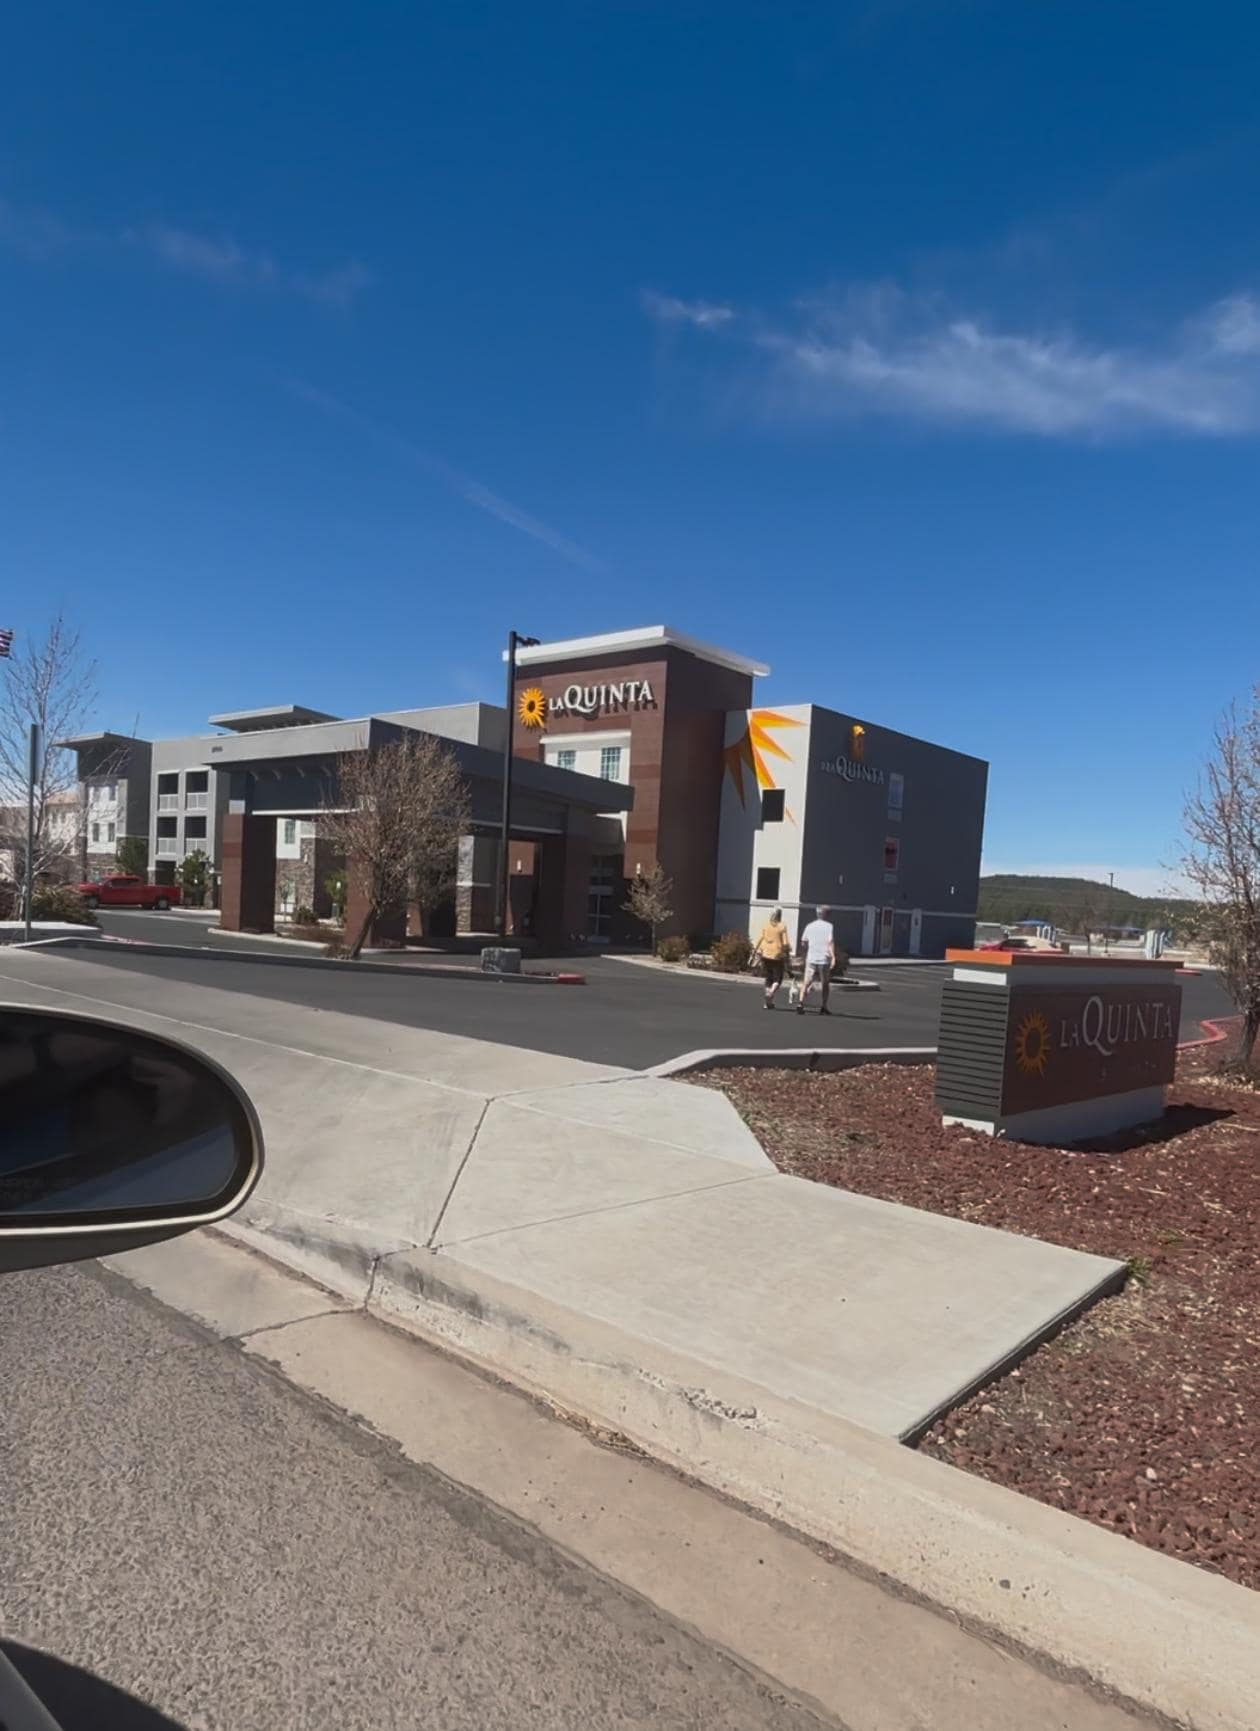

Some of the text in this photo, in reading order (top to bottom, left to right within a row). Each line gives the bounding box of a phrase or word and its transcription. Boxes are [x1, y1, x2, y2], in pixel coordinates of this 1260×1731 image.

[549, 680, 653, 713] LA QUINTA
[835, 756, 885, 784] QUINTA
[1060, 996, 1173, 1056] LA QUINTA
